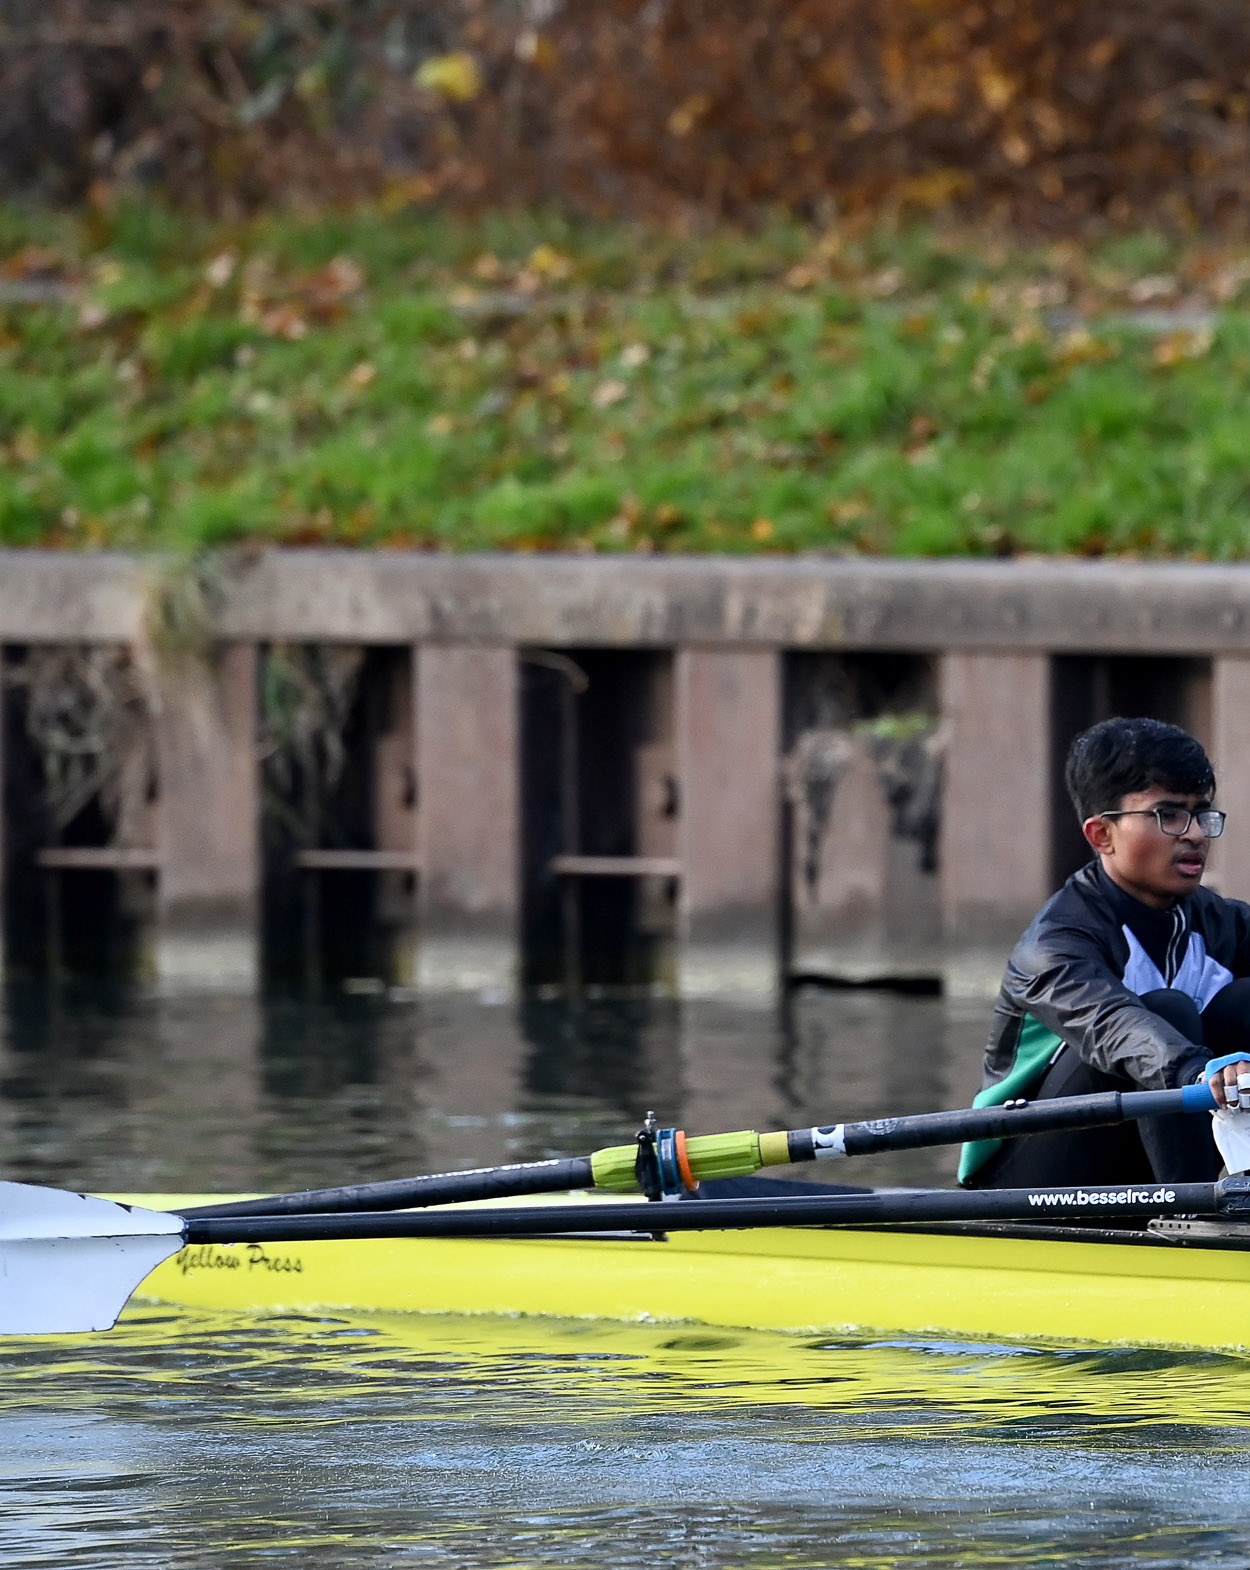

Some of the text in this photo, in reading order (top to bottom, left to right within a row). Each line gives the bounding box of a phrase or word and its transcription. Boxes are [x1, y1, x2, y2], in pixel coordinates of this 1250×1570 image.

[1027, 1187, 1176, 1206] www.besselrc.de
[176, 1244, 305, 1275] Yellow Press
